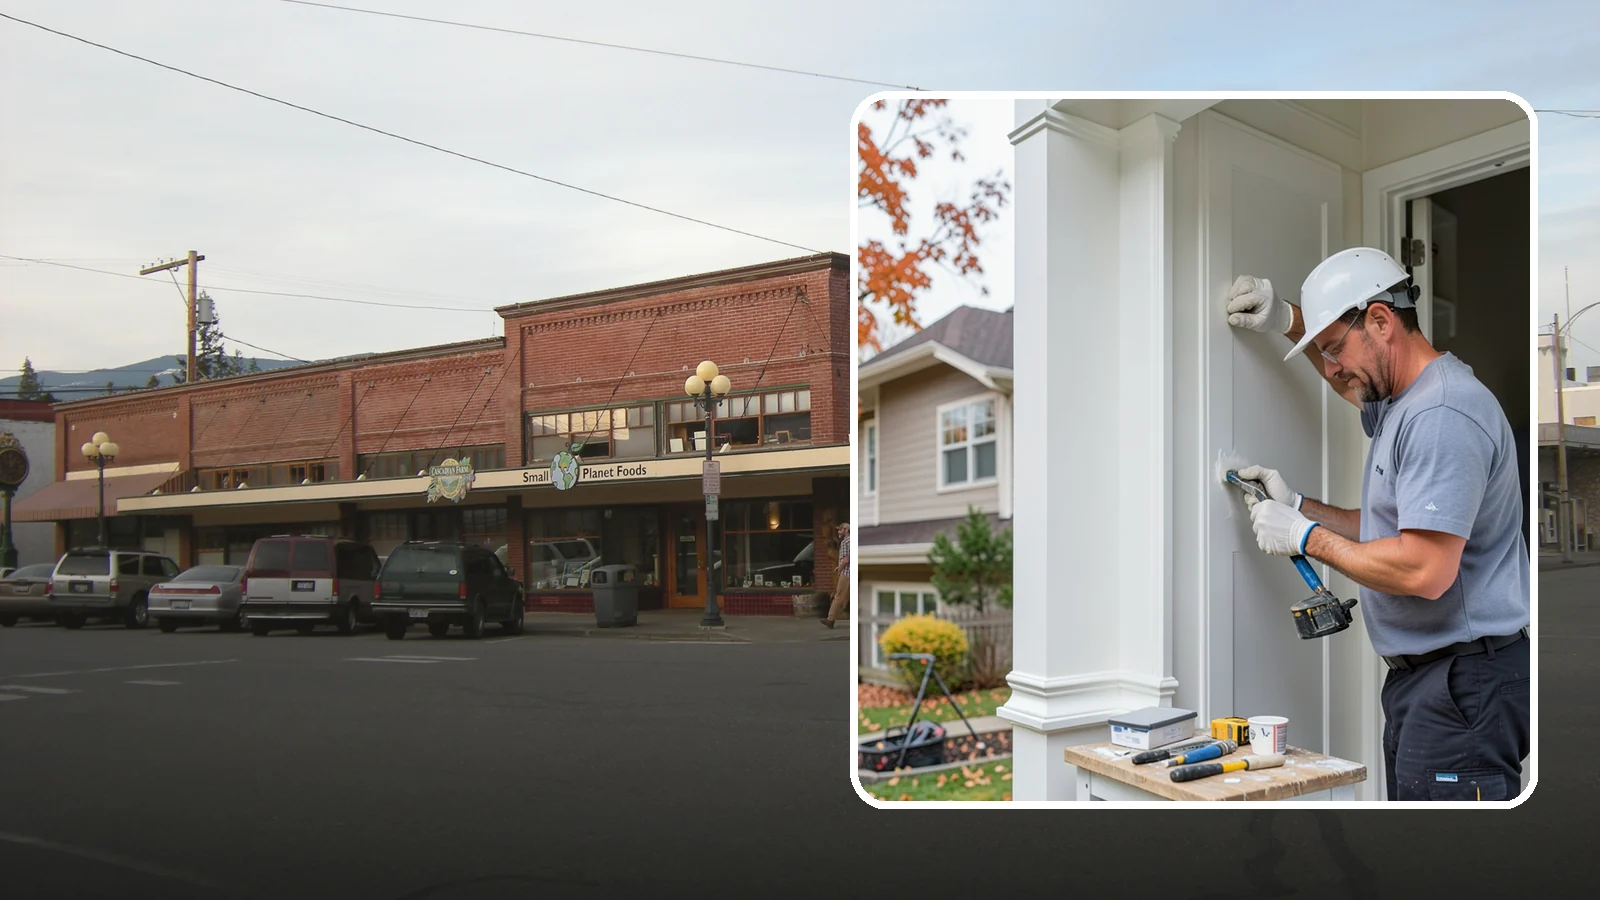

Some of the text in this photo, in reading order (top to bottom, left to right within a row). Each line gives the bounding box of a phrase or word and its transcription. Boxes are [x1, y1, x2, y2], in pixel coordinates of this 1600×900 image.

[523, 464, 647, 483] Small Planet Foods
